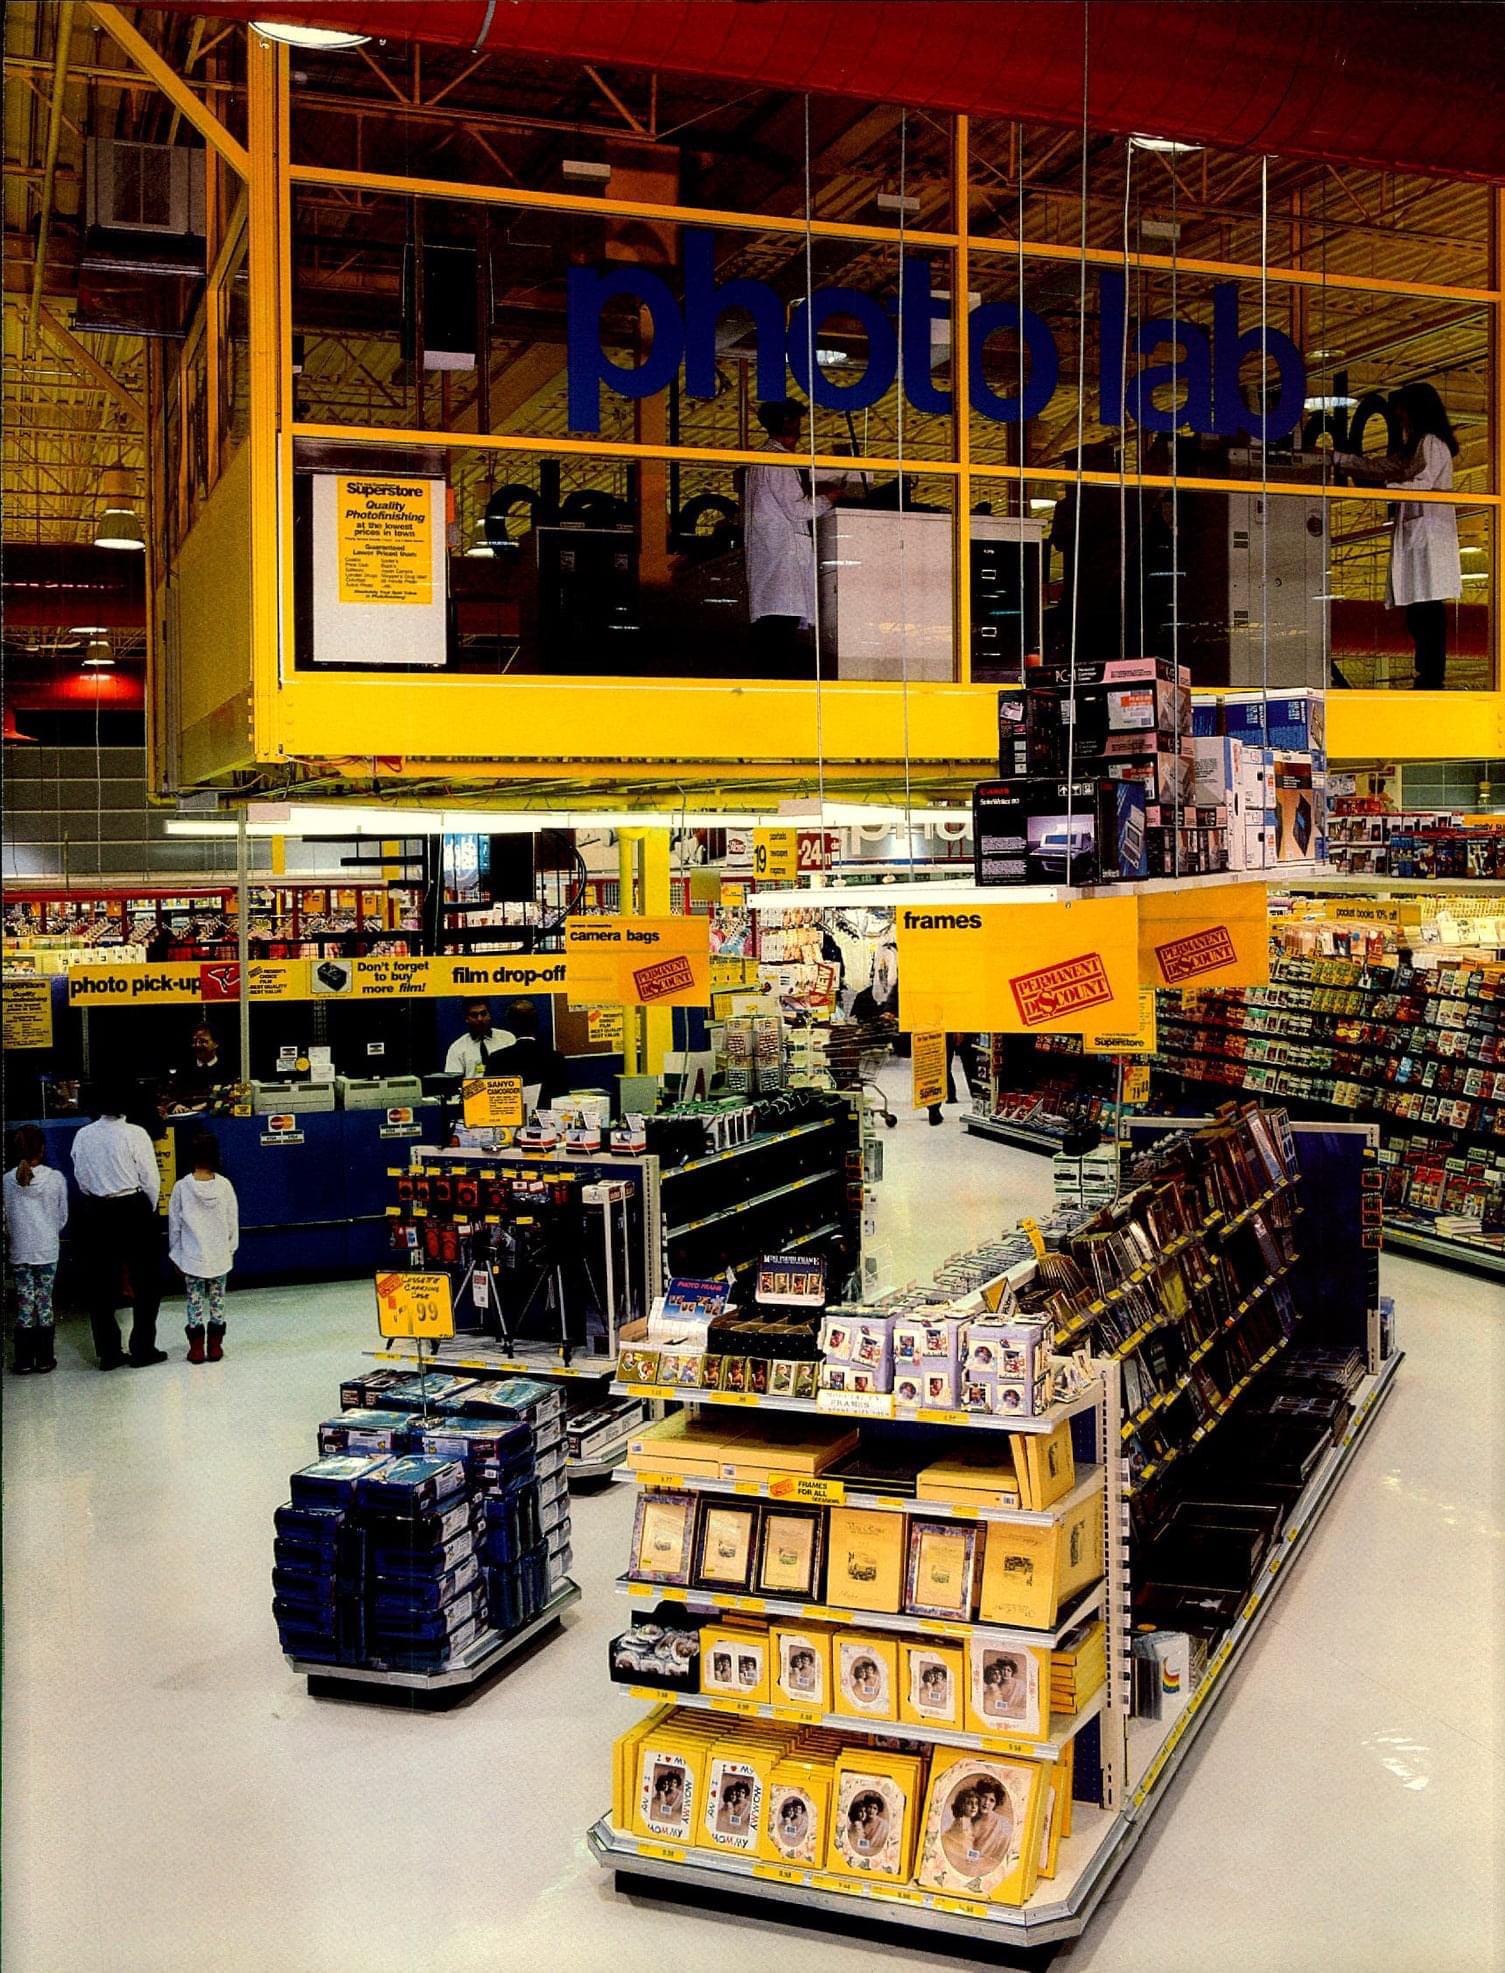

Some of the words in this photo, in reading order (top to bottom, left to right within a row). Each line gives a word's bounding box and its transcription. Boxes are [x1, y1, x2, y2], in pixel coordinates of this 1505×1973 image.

[567, 229, 1058, 432] photo
[1100, 270, 1307, 442] lab
[346, 482, 423, 498] Superstore
[366, 500, 405, 512] Quality
[345, 510, 425, 523] Photofinishing
[903, 911, 983, 929] frames
[570, 930, 621, 942] camera
[626, 929, 660, 944] bags
[1162, 930, 1227, 961] PERMANENT
[357, 961, 389, 971] Don't
[393, 961, 429, 972] forget
[374, 973, 386, 981] to
[391, 972, 412, 983] buy
[453, 967, 488, 984] film
[493, 965, 566, 986] drop-off
[1017, 957, 1100, 995] PERMANENT
[71, 976, 128, 998] photo
[132, 975, 201, 997] pick-up
[362, 985, 394, 993] more
[399, 983, 426, 992] film!
[487, 1080, 514, 1088] SANYO
[798, 1480, 828, 1489] FRAMES
[798, 1488, 813, 1496] FOR
[814, 1489, 828, 1497] ALL
[682, 1780, 692, 1824] MOMMY
[751, 1785, 761, 1831] MOMMY
